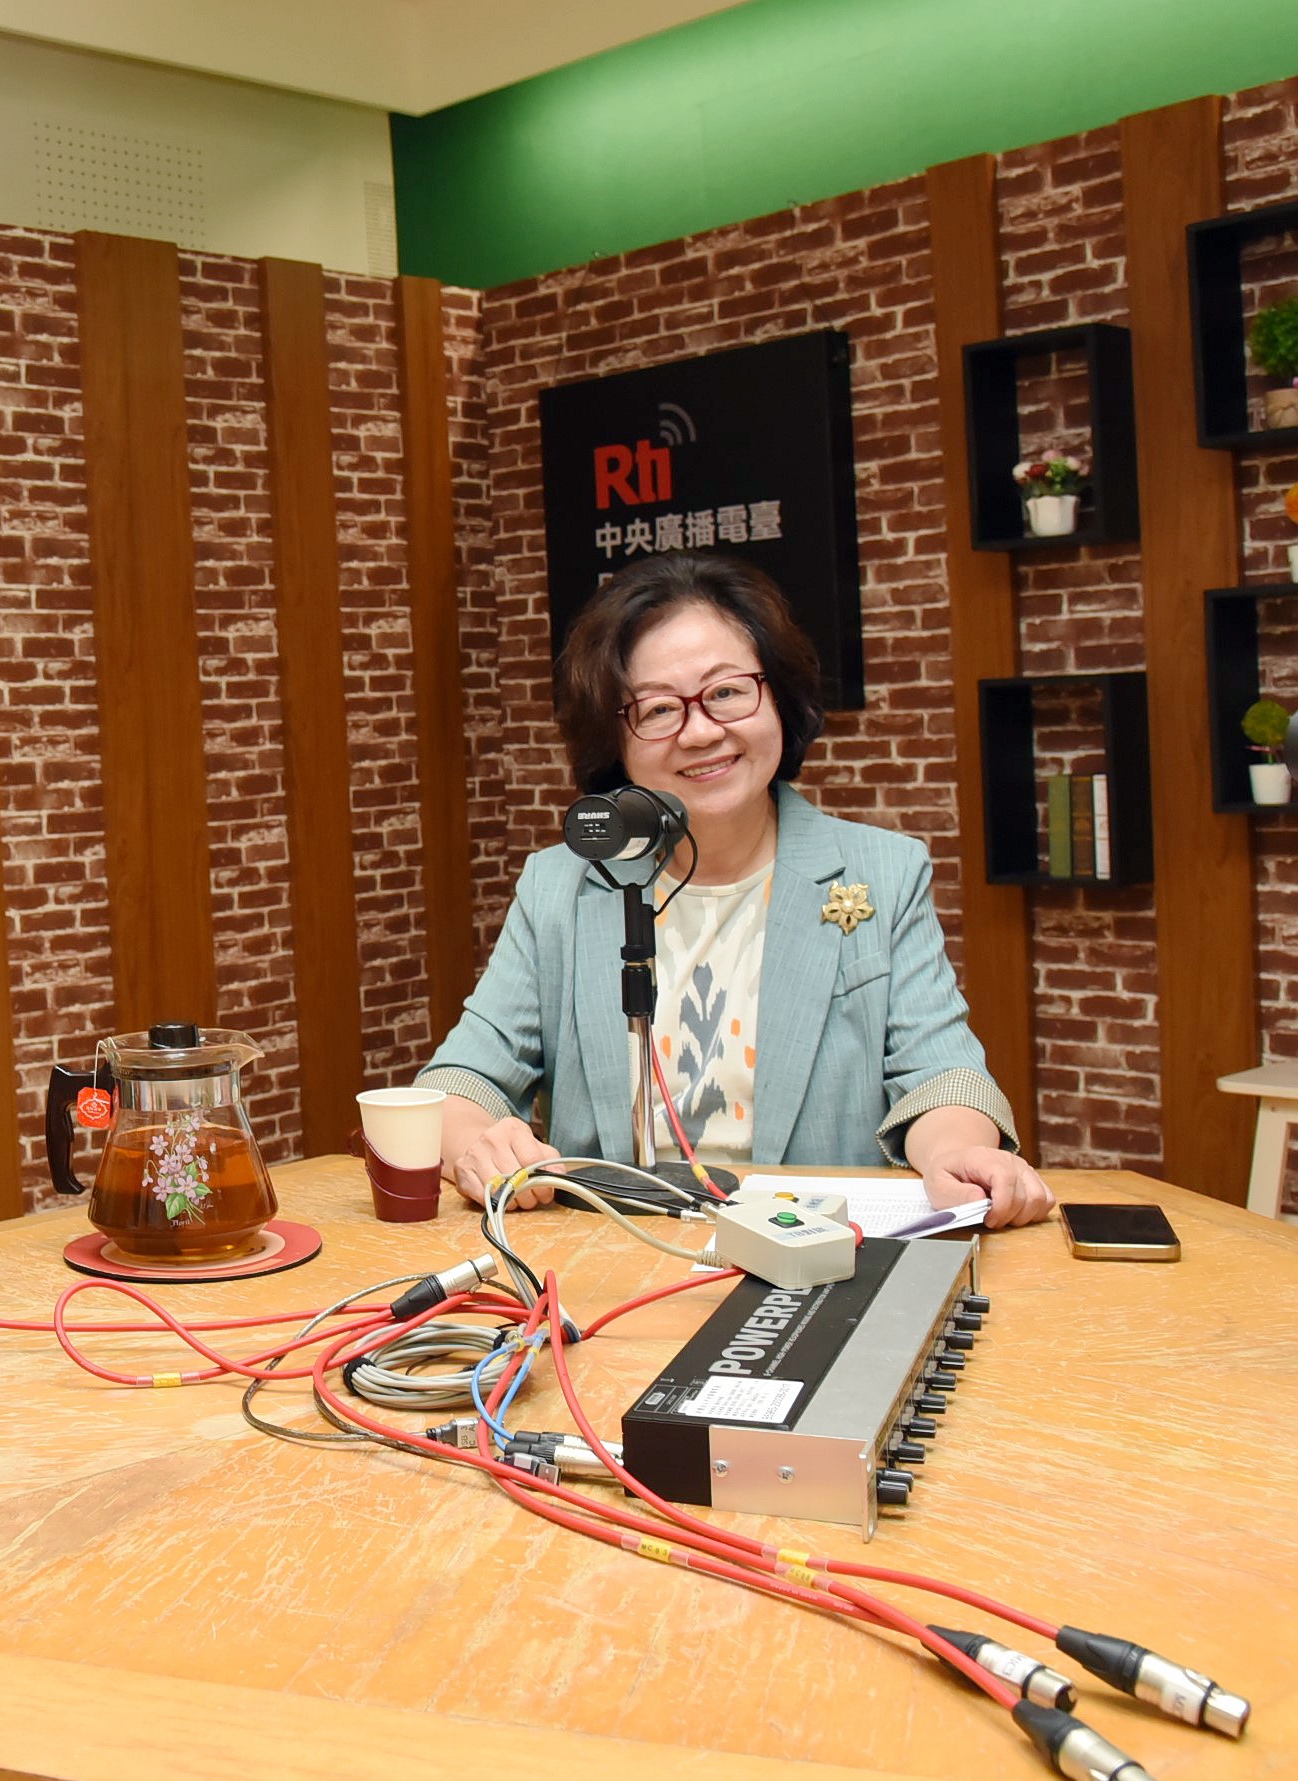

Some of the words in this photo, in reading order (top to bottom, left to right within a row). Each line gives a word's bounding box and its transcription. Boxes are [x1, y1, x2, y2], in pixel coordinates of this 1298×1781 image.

[595, 500, 783, 559] 中央廣播電臺
